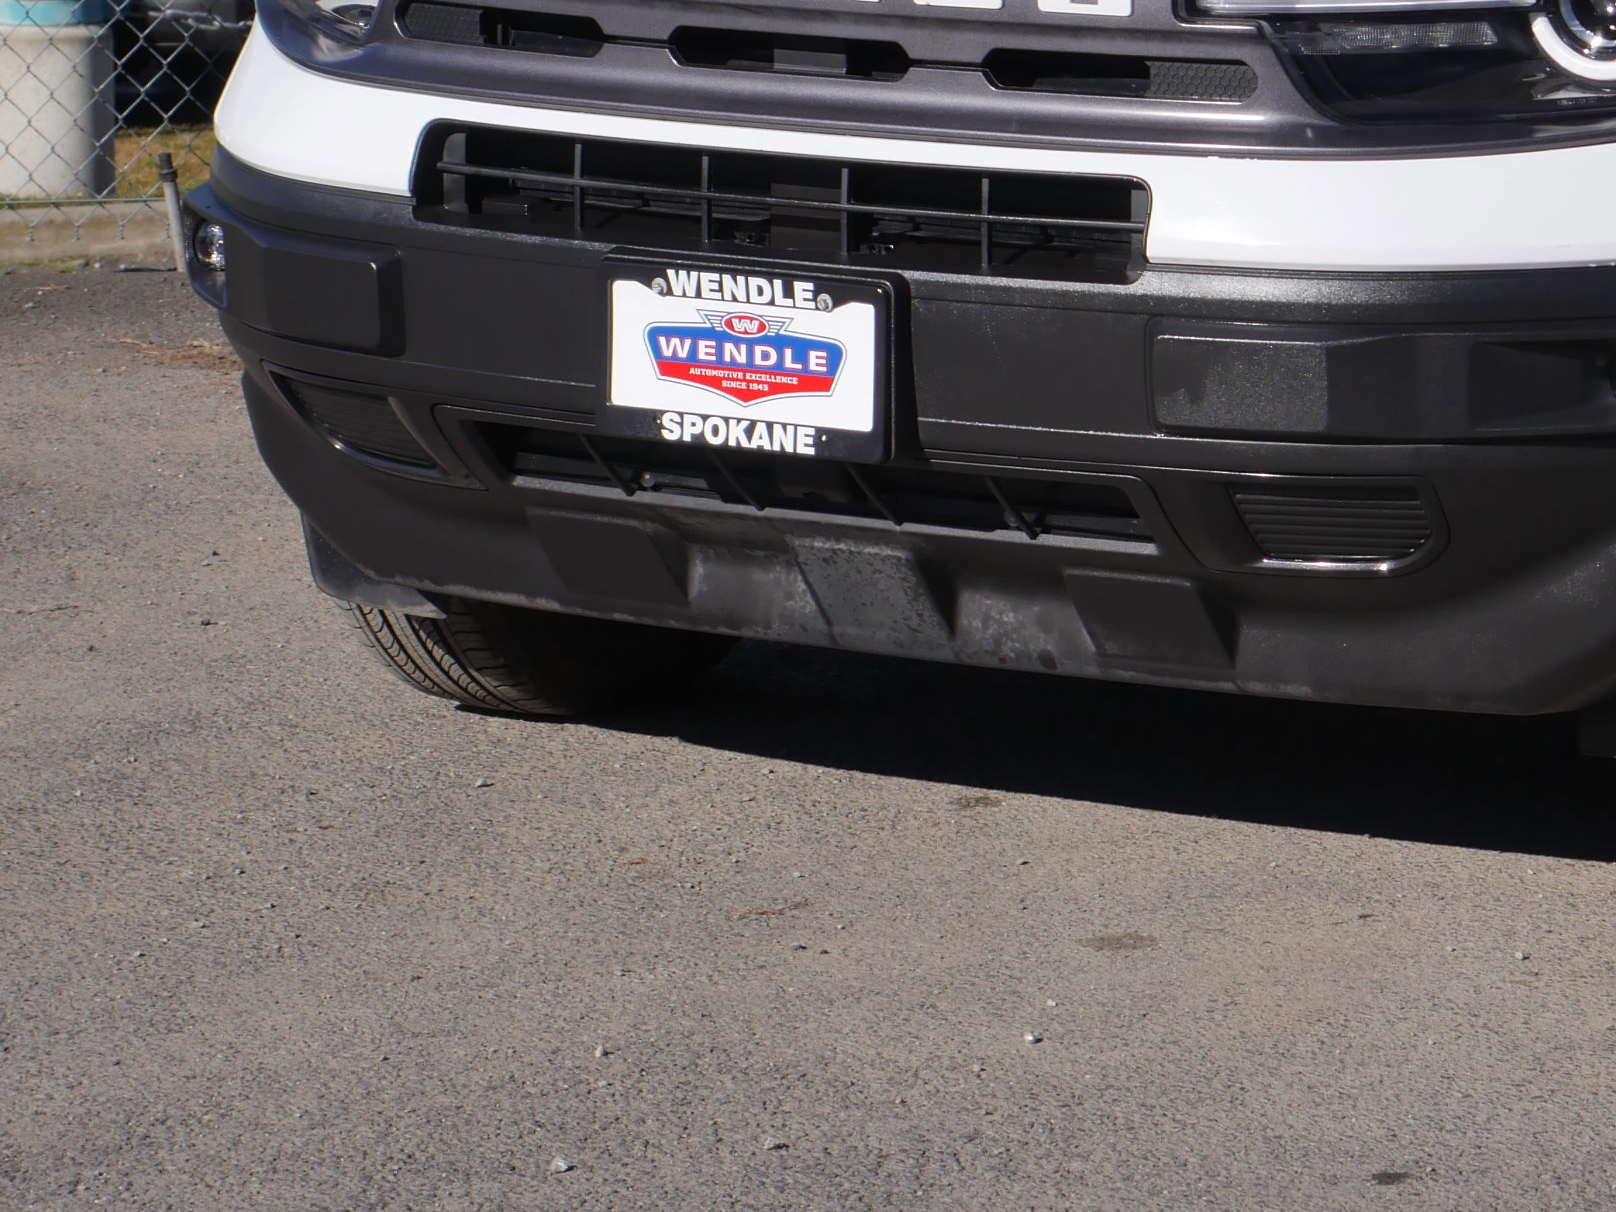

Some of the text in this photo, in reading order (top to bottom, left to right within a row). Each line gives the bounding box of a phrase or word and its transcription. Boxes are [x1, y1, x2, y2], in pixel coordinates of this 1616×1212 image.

[666, 269, 816, 310] WENDLE
[657, 335, 828, 372] WENDLE
[689, 367, 798, 385] AUTOMOTIVE EXCELLENCE
[721, 380, 769, 391] SINCE 1943
[661, 412, 816, 455] SPOKANE
